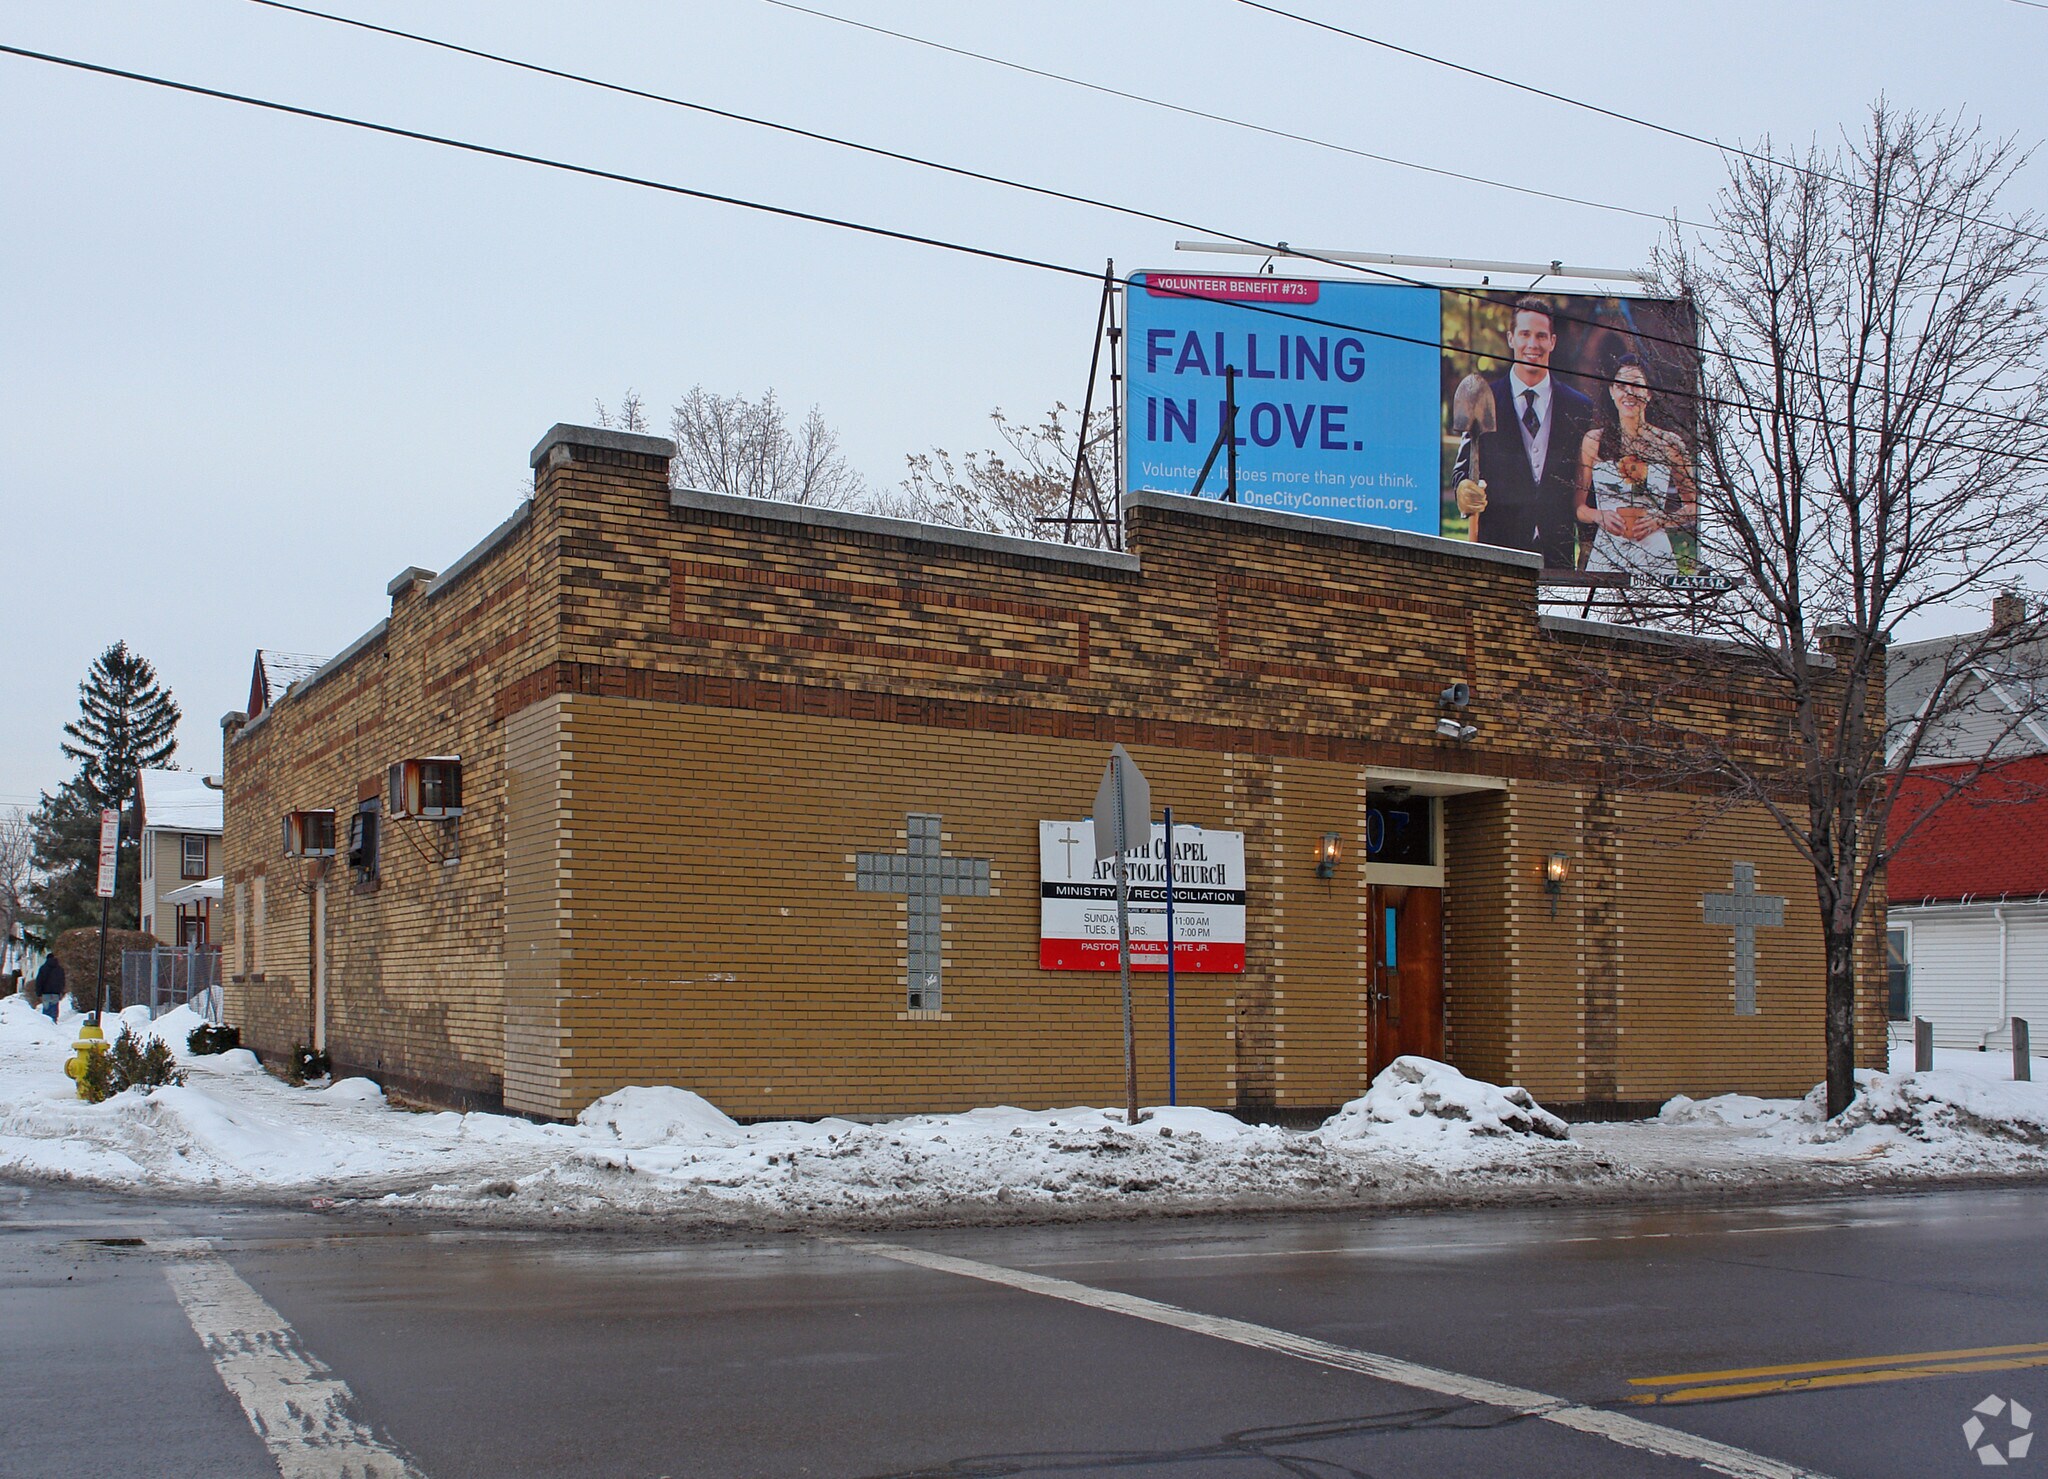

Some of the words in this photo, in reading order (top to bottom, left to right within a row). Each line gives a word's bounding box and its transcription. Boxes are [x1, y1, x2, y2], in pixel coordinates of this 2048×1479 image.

[1158, 278, 1227, 292] VOLUNTEER
[1230, 281, 1279, 294] BENEFIT
[1282, 284, 1308, 295] #73:
[1147, 329, 1366, 382] FALLING
[1147, 397, 1197, 443] IN
[1219, 400, 1364, 451] LOVE.
[1142, 461, 1214, 480] Voluntee.
[1219, 465, 1229, 480] It
[1235, 466, 1267, 481] does
[1272, 471, 1310, 484] more
[1315, 470, 1345, 485] than
[1350, 473, 1374, 488] you
[1379, 473, 1418, 488] think.
[1244, 489, 1418, 513] OneCityConnection.org.
[1155, 837, 1208, 862] CAPEL
[1173, 863, 1227, 885] CHURCH
[1056, 885, 1116, 897] MINISTRY
[1134, 889, 1235, 902] RECONCILIATION
[1084, 925, 1109, 935] TUES.
[1110, 926, 1116, 935] &
[1119, 926, 1148, 936] URS.
[1180, 928, 1197, 937] 7:00
[1198, 928, 1211, 937] PM
[1175, 917, 1194, 926] 11:00
[1196, 918, 1210, 926] AM
[1081, 942, 1119, 951] PASTOR
[1129, 943, 1161, 952] AMUEL
[1196, 943, 1209, 952] JR.
